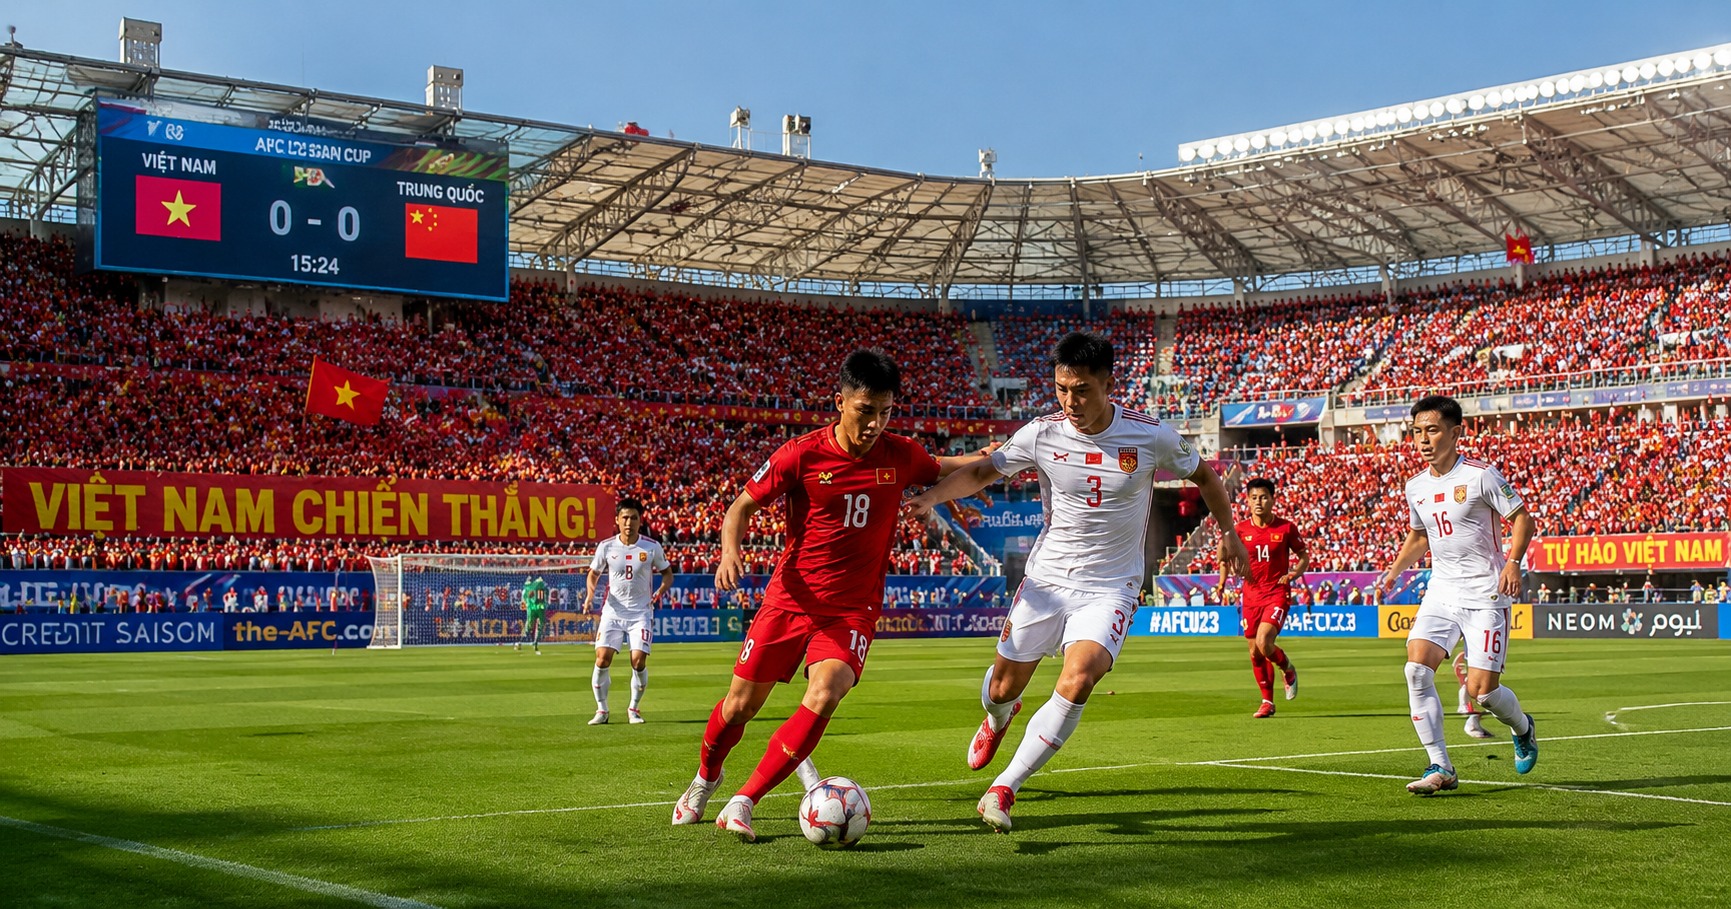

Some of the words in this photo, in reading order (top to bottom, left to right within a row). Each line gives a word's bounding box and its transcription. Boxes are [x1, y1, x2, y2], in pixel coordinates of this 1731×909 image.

[181, 157, 217, 176] NAM
[344, 148, 372, 164] CUP
[397, 181, 443, 199] TRUNG
[269, 199, 292, 236] 0
[337, 206, 361, 242] 0
[291, 254, 340, 275] 15:24
[1086, 475, 1103, 508] 3
[29, 471, 146, 540] VIỆT
[163, 486, 275, 533] NAM
[844, 493, 870, 528] 18
[1432, 511, 1454, 538] 16
[1255, 544, 1270, 563] 14
[1675, 539, 1723, 563] NAM
[1149, 611, 1220, 634] #AFCU23
[1548, 613, 1615, 631] NEOM
[849, 629, 868, 664] 18
[1484, 630, 1501, 653] 16
